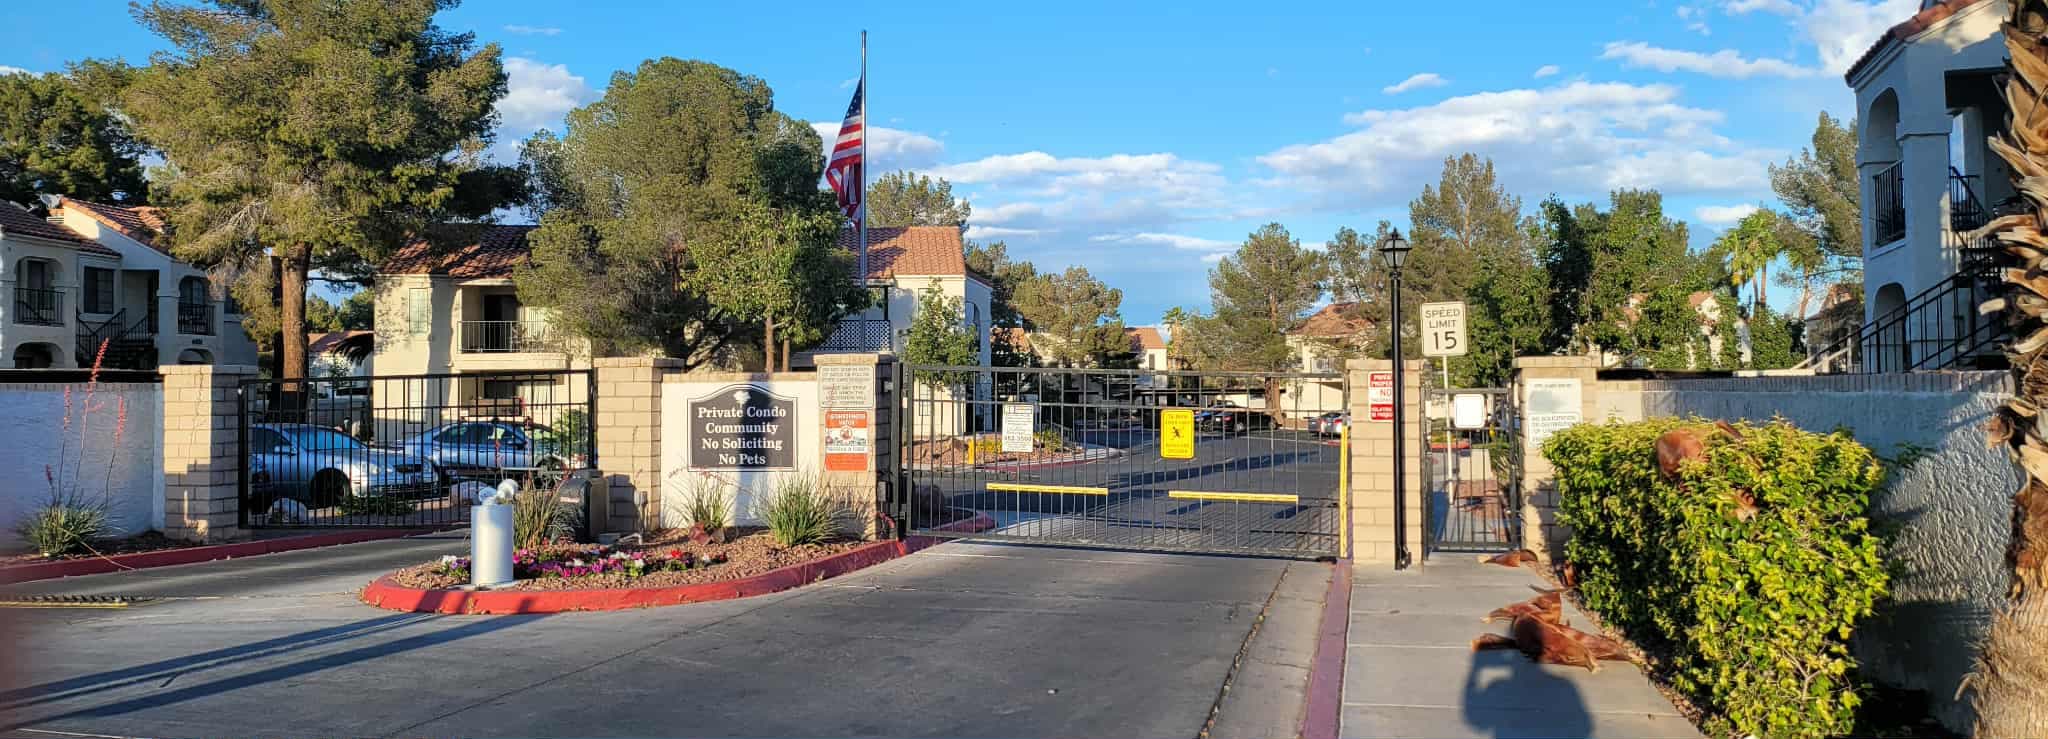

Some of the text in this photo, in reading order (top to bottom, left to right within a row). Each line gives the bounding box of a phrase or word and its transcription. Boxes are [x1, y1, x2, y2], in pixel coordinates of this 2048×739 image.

[1425, 309, 1460, 318] SPEED
[1429, 320, 1457, 328] LIMIT
[1433, 331, 1457, 350] 15
[697, 406, 786, 418] Private Condo
[705, 422, 778, 435] Community
[702, 437, 784, 451] No Soliciting
[718, 453, 766, 465] No Pets
